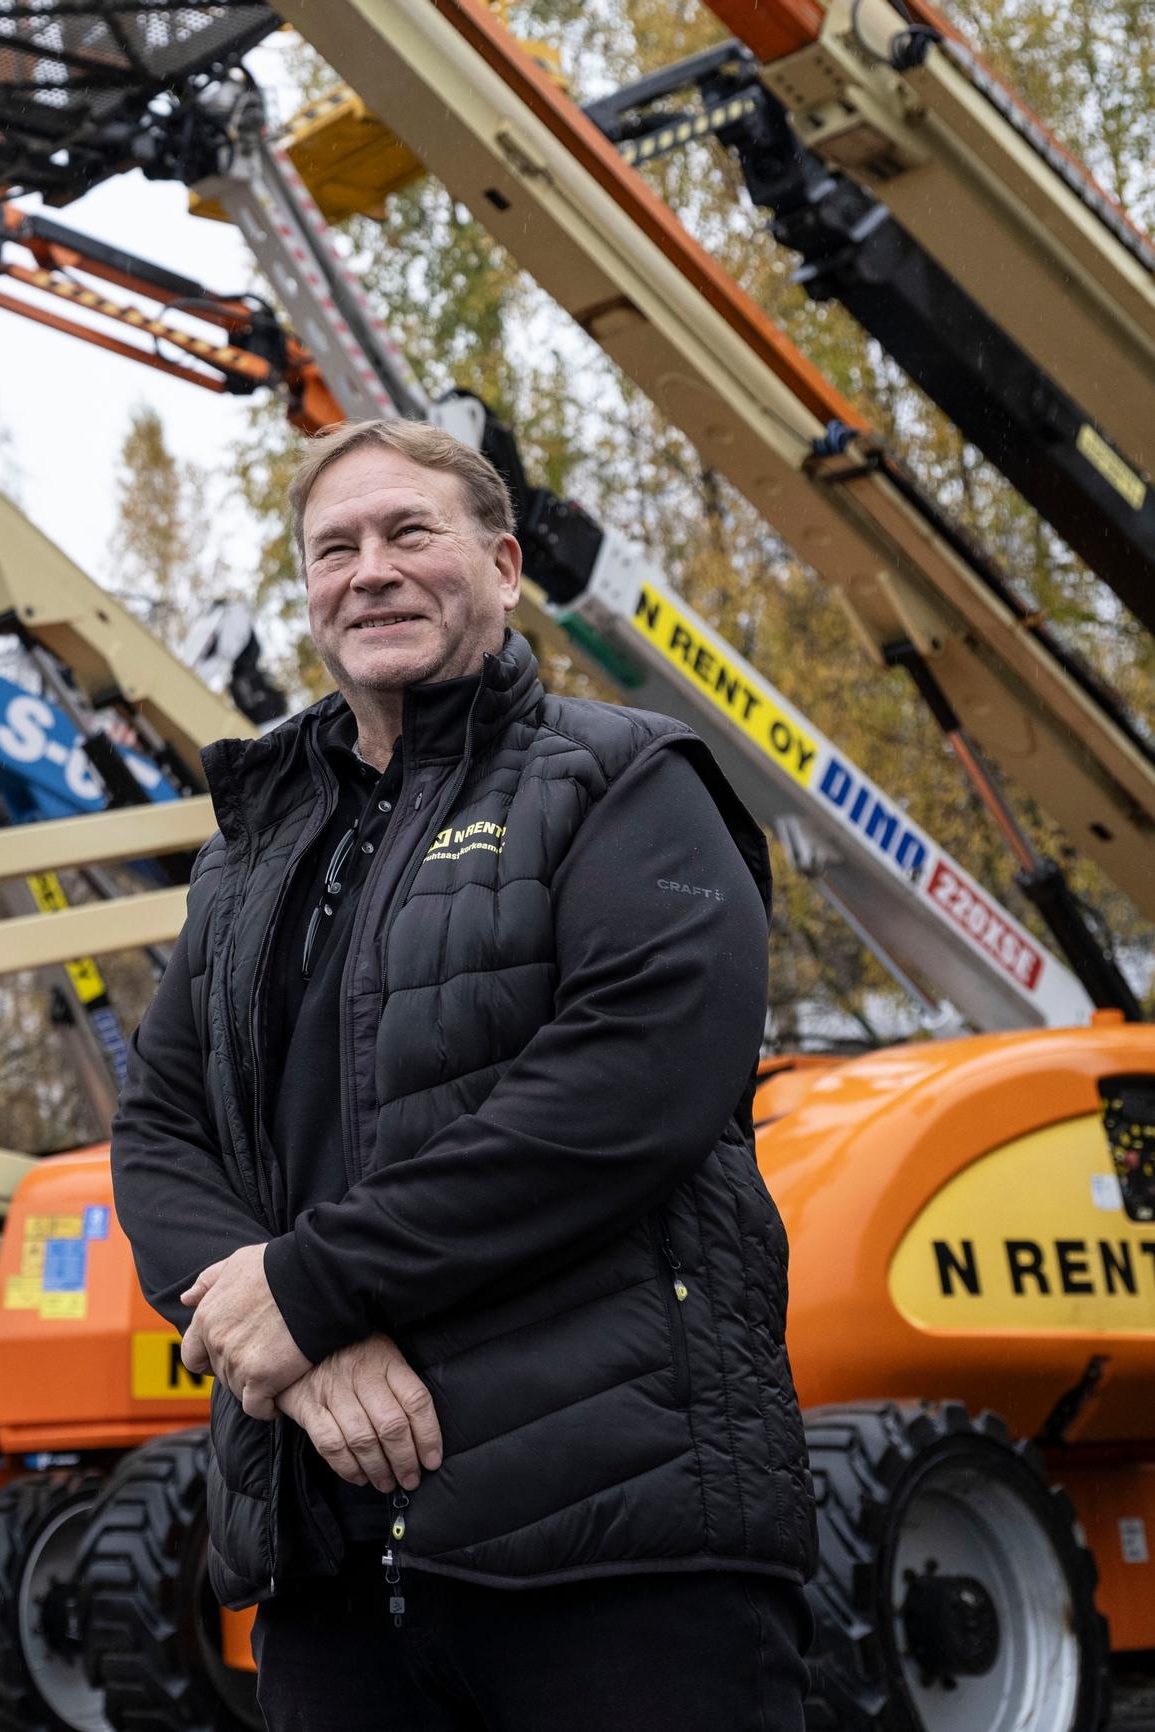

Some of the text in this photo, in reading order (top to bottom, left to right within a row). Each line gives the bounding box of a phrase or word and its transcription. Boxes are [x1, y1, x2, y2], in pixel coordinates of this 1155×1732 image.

[634, 590, 814, 772] N RENT OY
[657, 878, 712, 898] CRAFT
[932, 1239, 982, 1296] N
